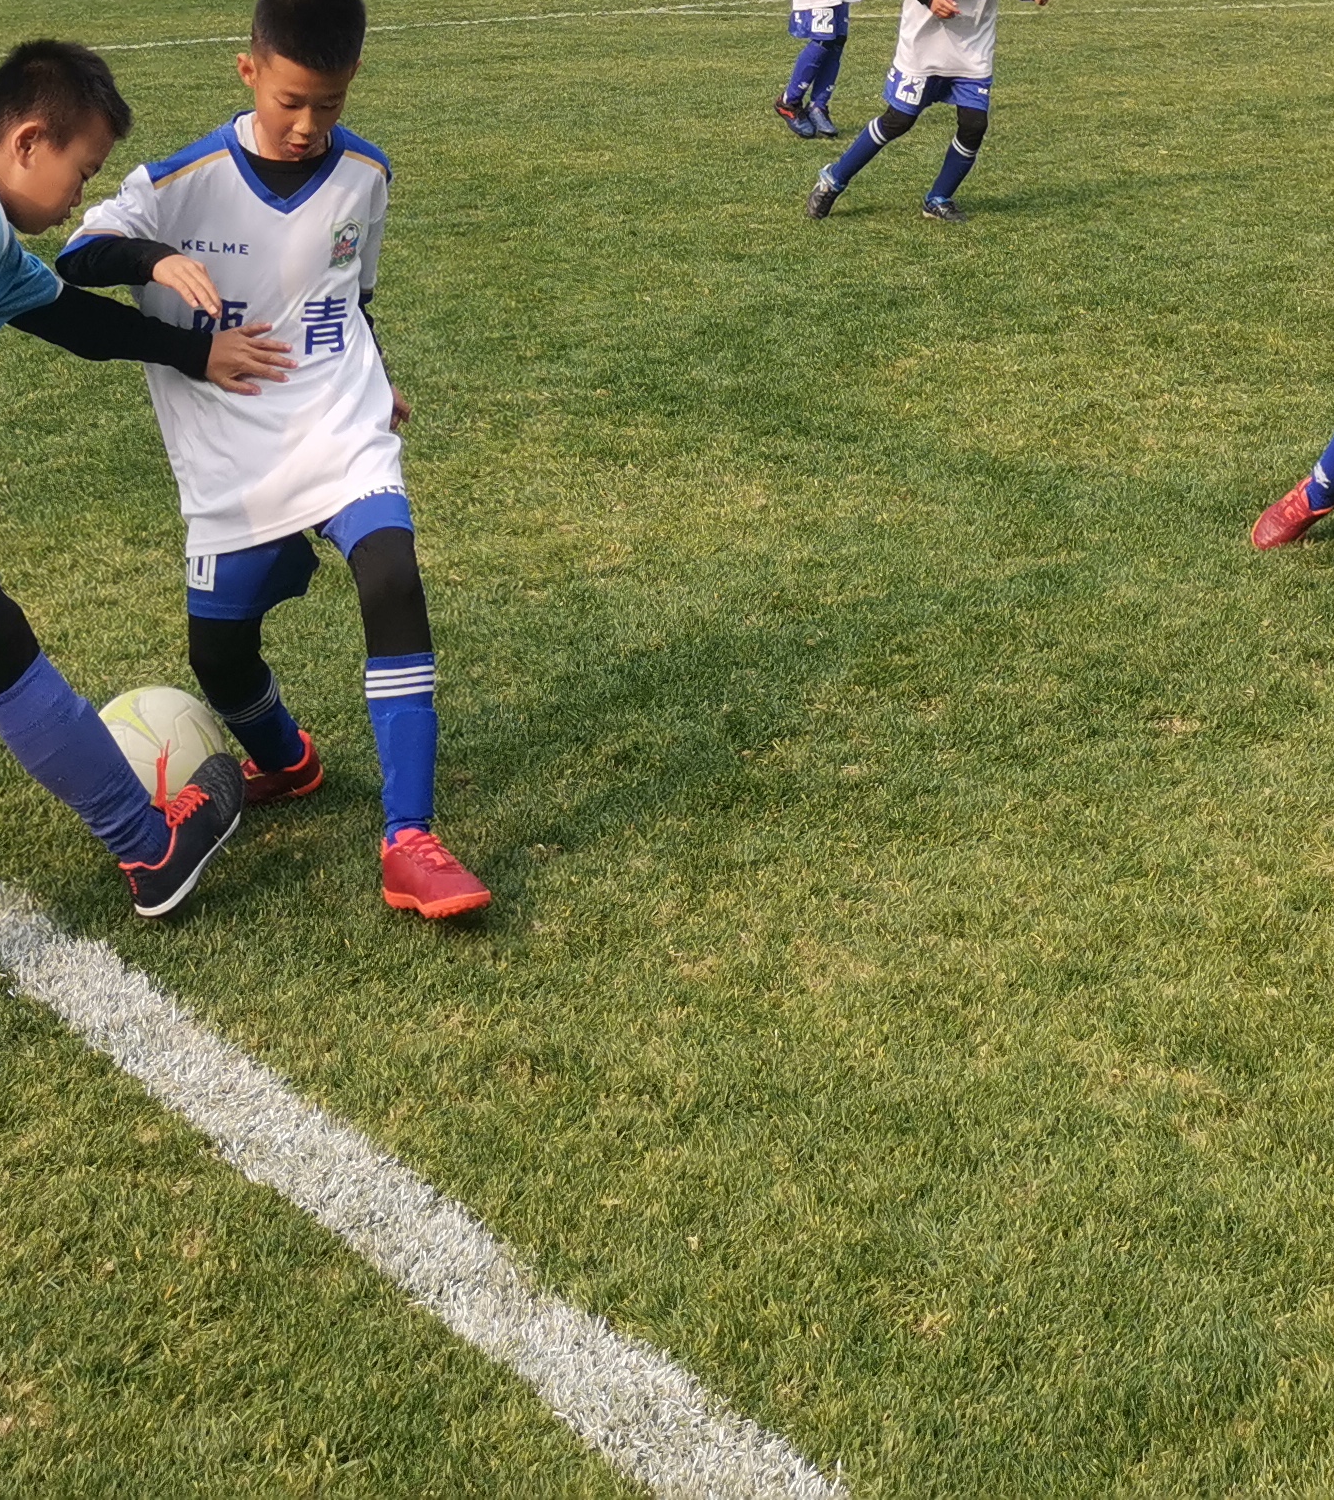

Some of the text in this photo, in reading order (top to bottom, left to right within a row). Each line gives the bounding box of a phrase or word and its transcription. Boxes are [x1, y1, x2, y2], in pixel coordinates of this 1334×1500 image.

[811, 8, 834, 33] 22
[895, 74, 928, 106] 23
[181, 239, 249, 255] KELME
